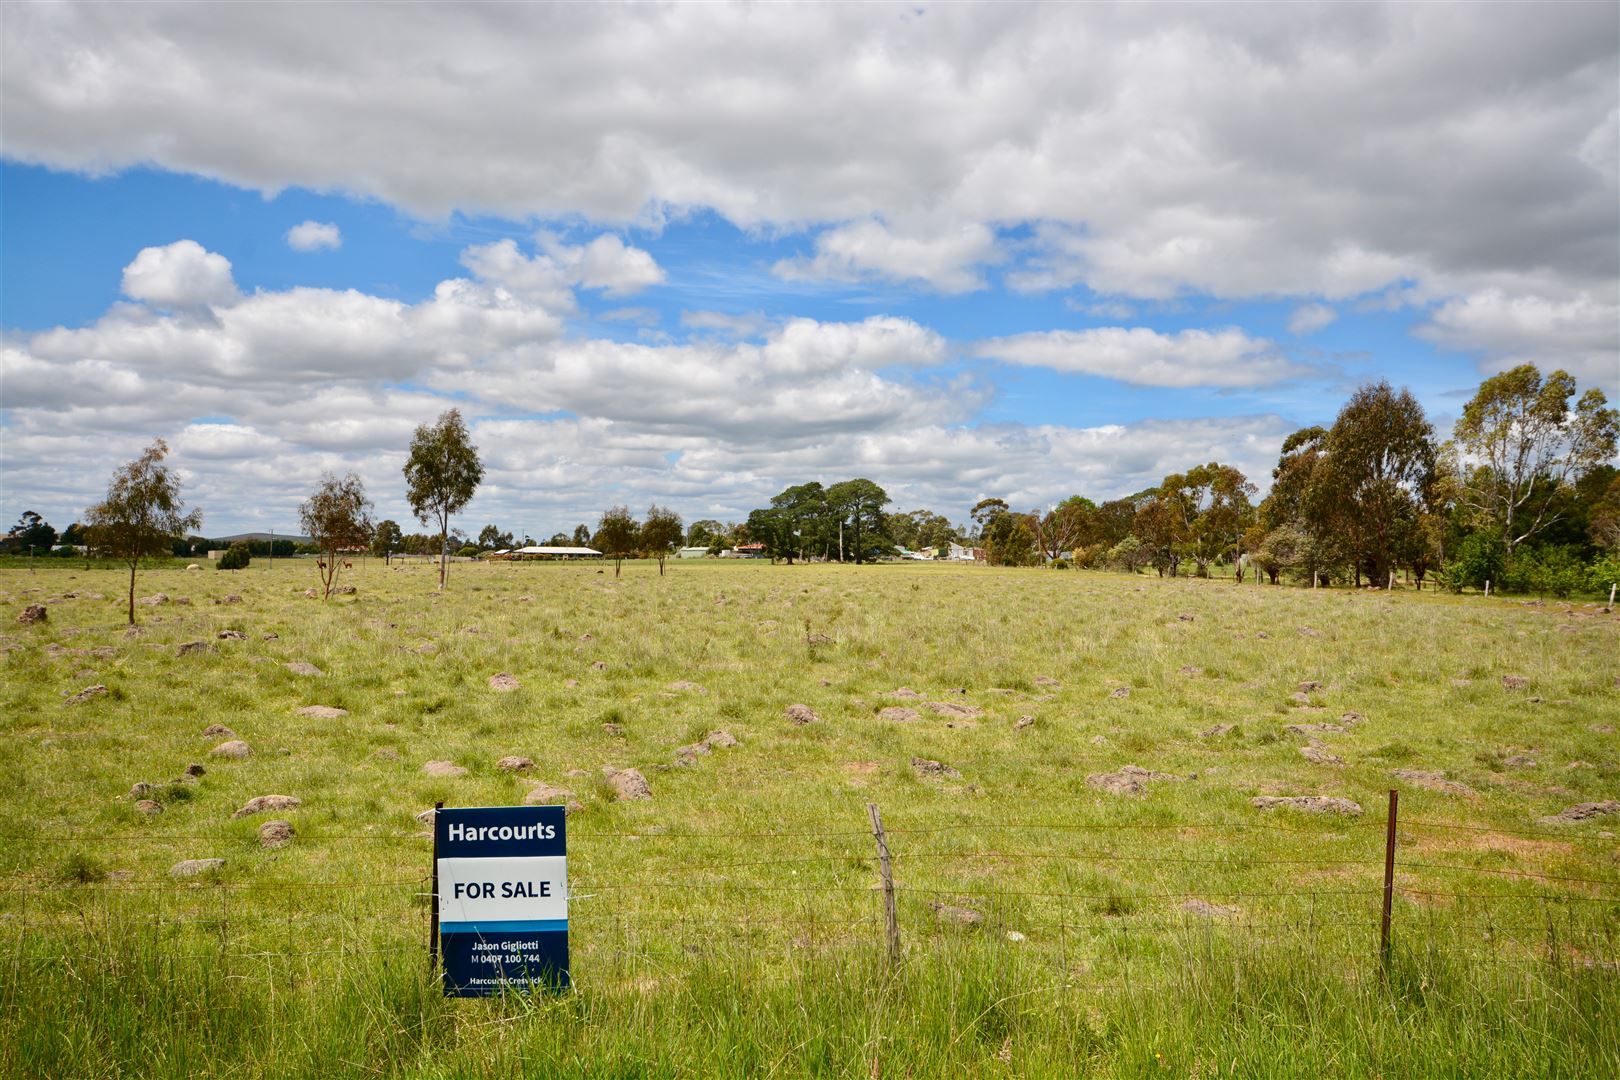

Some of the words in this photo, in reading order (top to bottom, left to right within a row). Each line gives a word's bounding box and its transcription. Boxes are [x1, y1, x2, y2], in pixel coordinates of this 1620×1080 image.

[448, 822, 556, 842] Harcourts
[454, 882, 496, 900] FOR
[501, 881, 552, 899] SALE
[471, 941, 499, 951] Jason
[501, 940, 539, 952] Gigliotti
[471, 955, 479, 964] M
[480, 955, 503, 964] 0407
[505, 954, 522, 963] 100
[523, 954, 540, 963] 744
